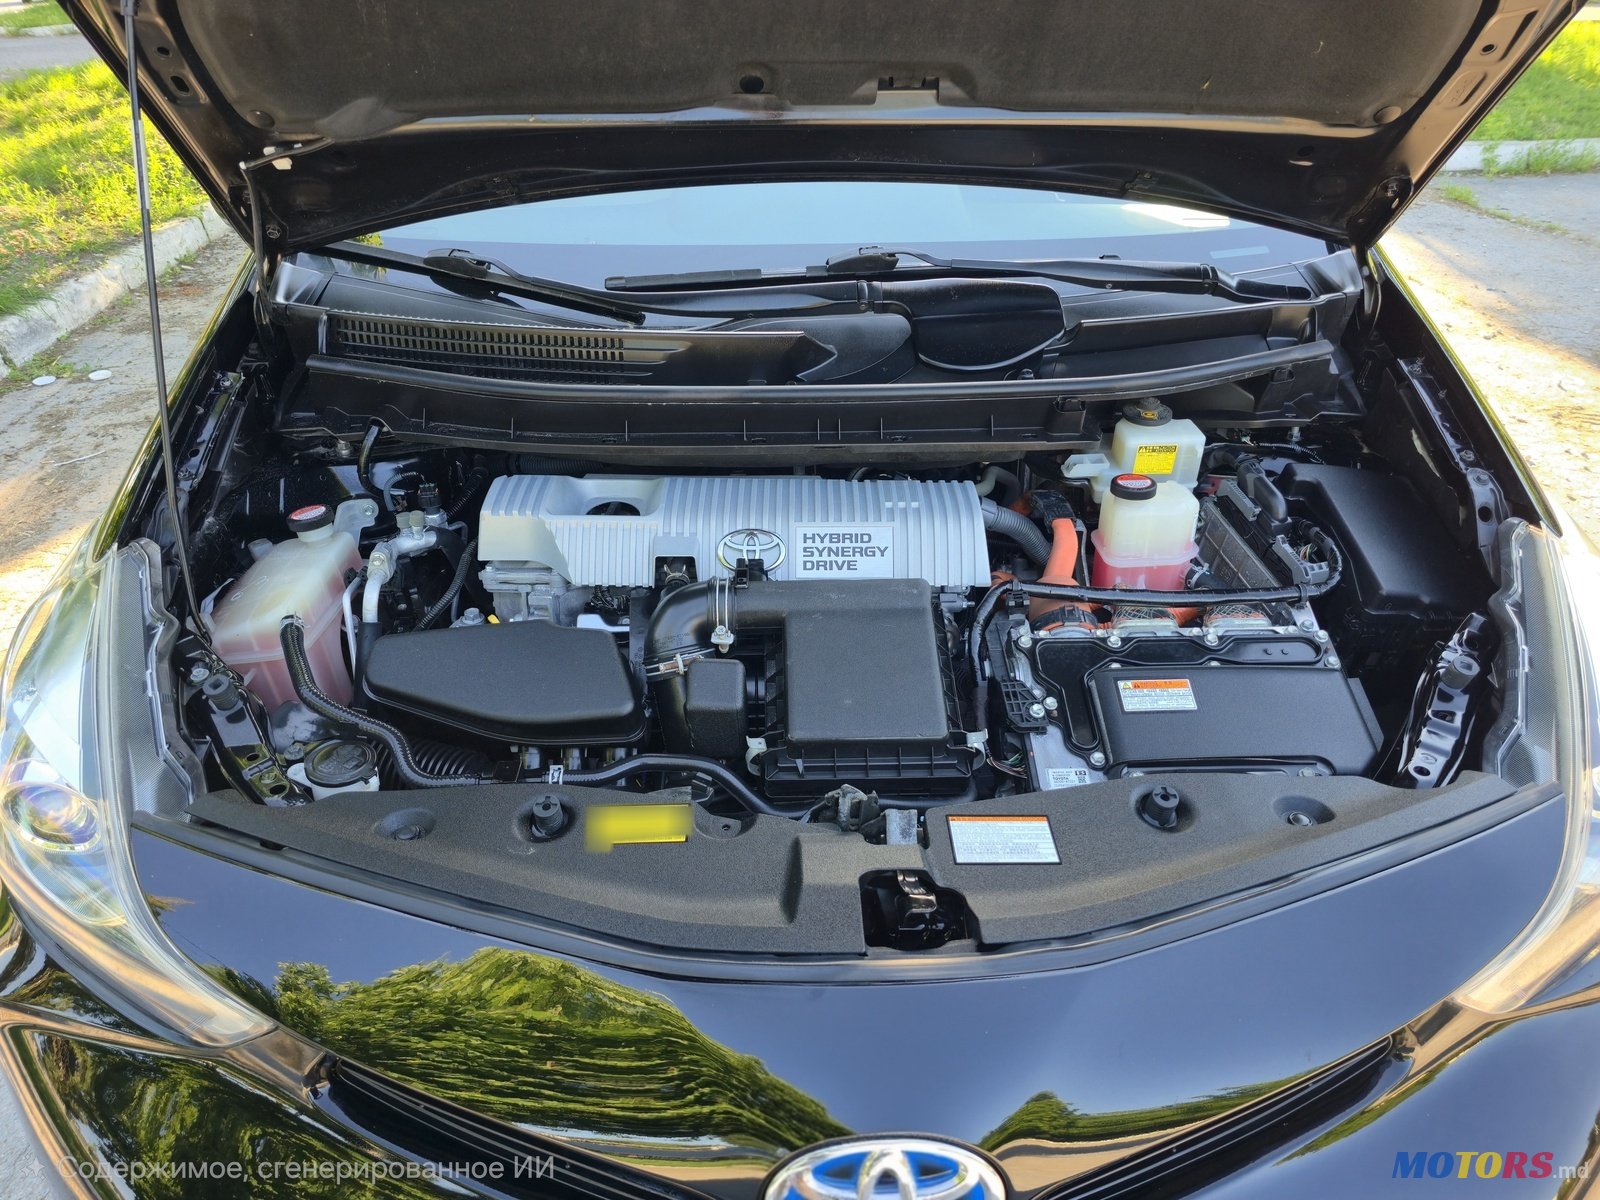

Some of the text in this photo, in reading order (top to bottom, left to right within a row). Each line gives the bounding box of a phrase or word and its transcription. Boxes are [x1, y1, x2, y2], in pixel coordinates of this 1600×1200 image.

[803, 533, 872, 544] HYBRID
[803, 546, 889, 557] SYNERGY
[803, 560, 858, 571] DRIVE
